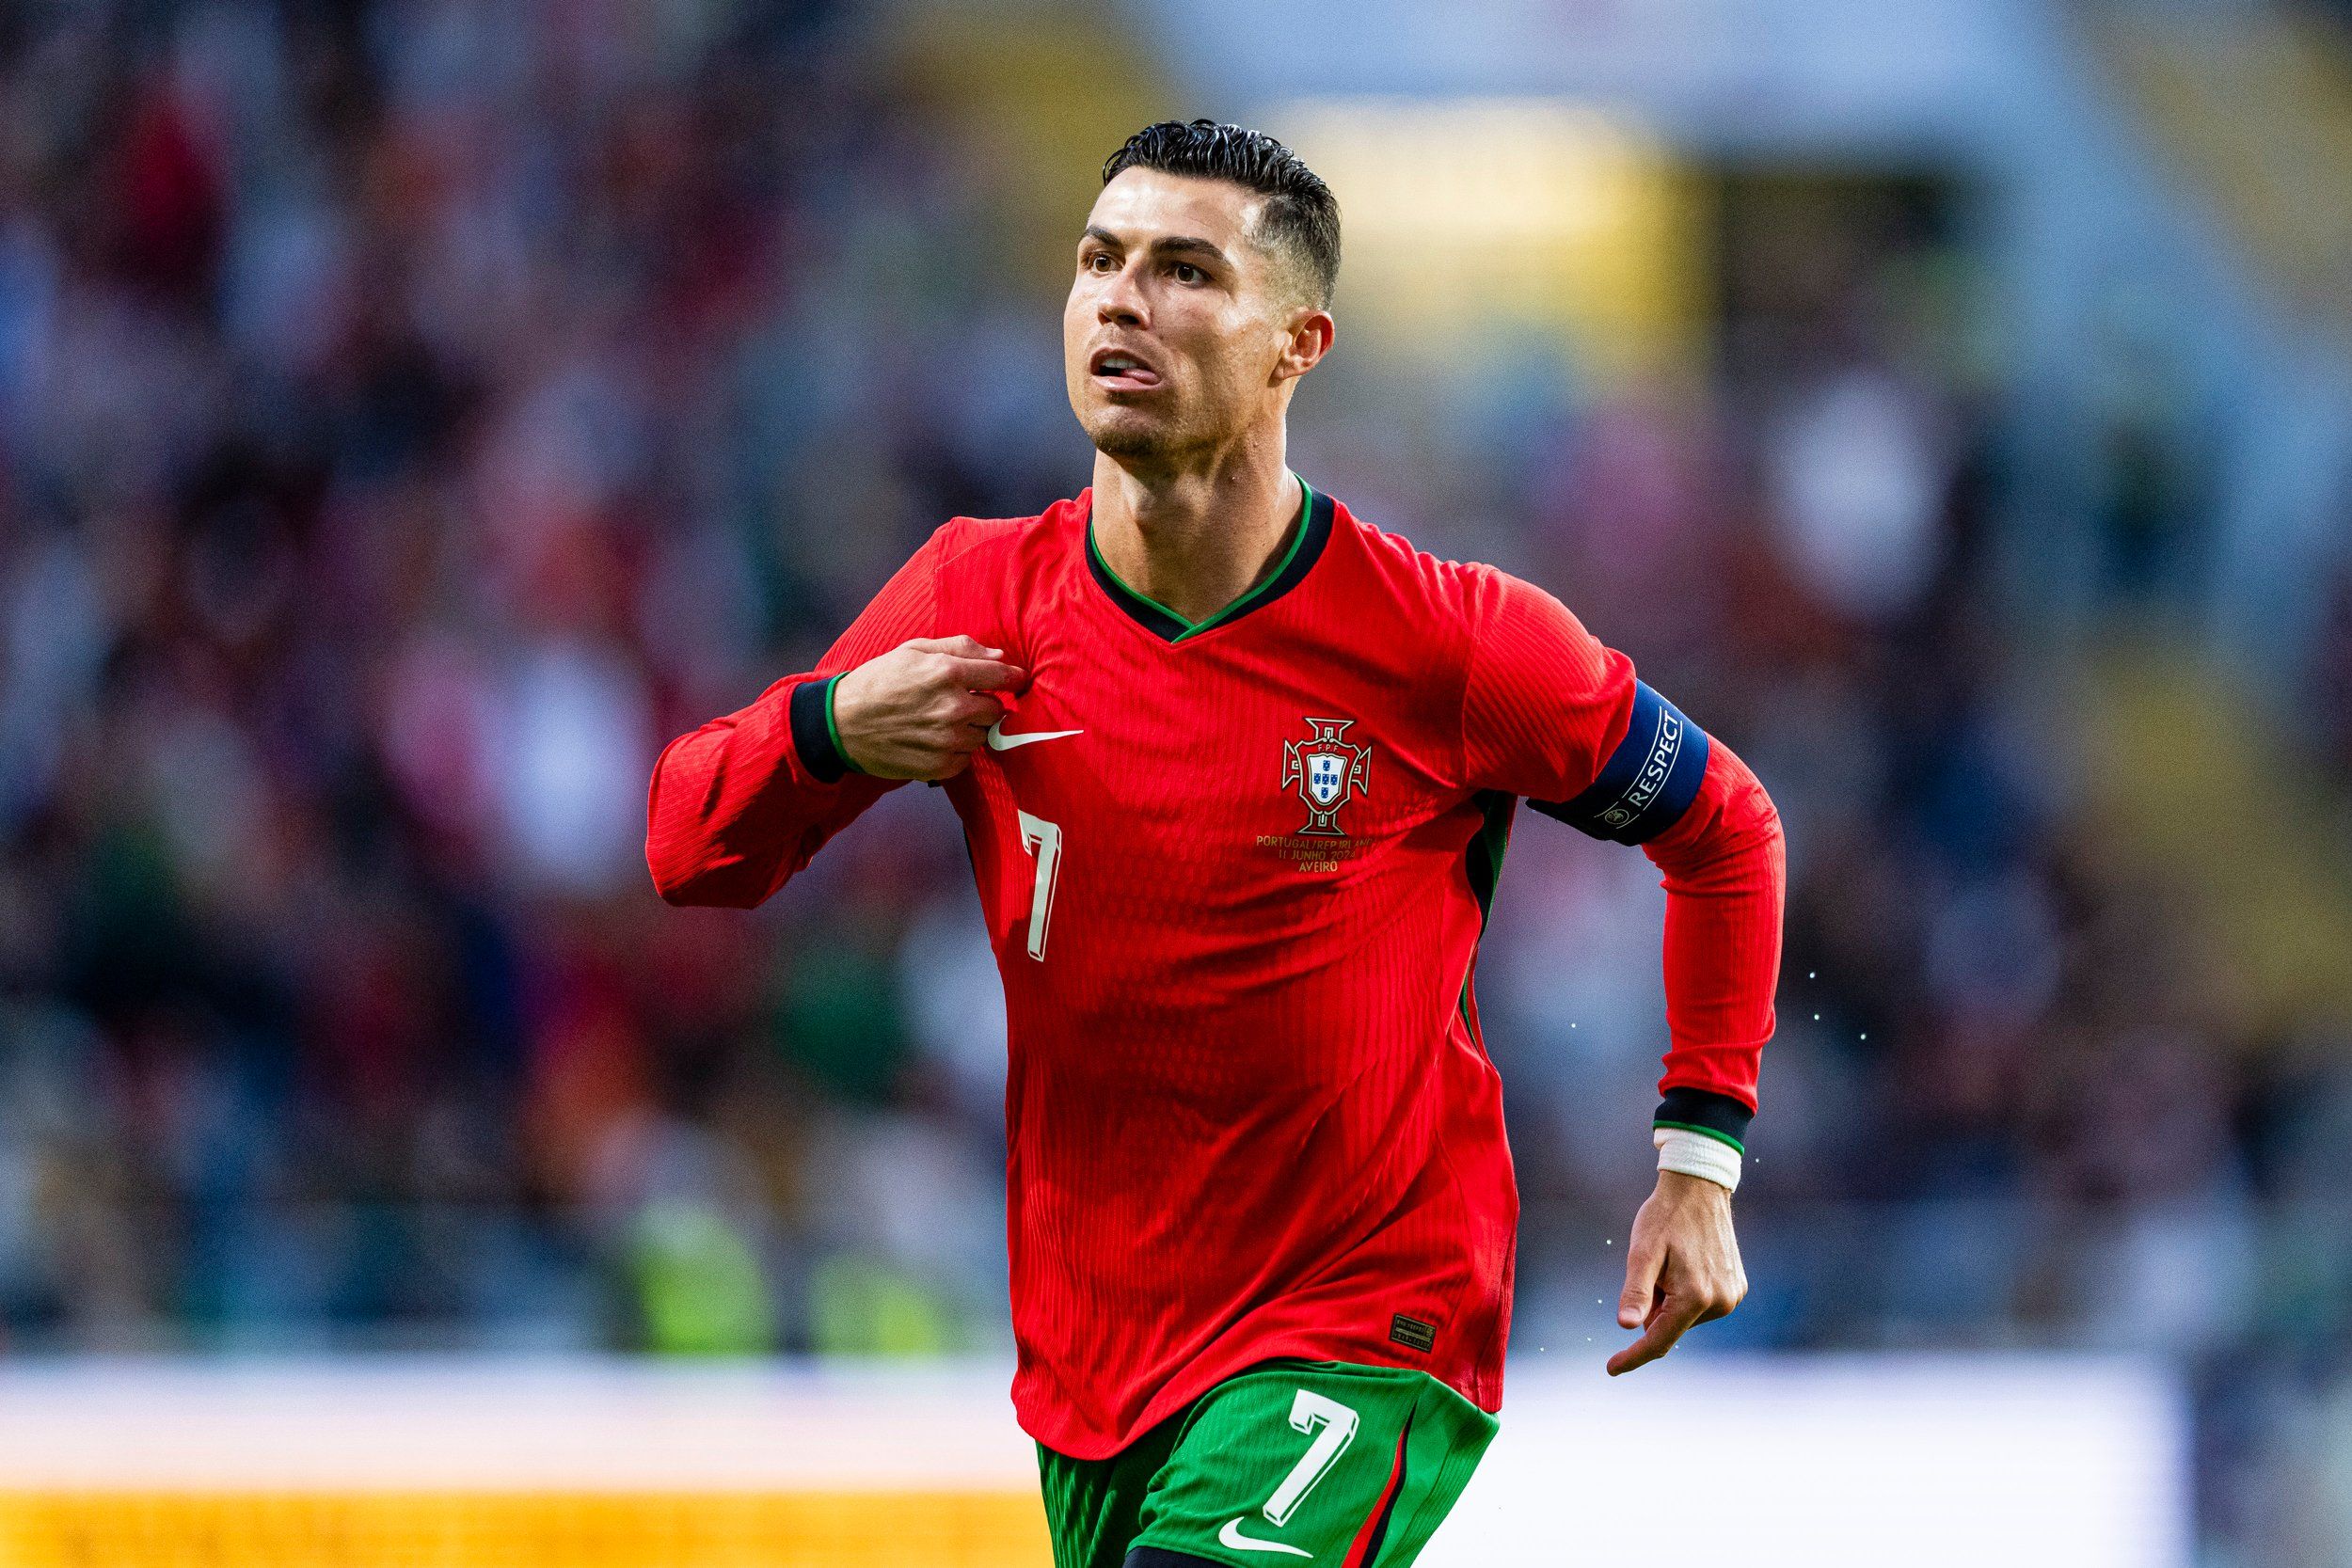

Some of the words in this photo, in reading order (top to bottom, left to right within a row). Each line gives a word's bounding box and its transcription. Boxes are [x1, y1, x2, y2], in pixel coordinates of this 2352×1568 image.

[1628, 709, 1679, 807] RESPECT
[1017, 808, 1062, 963] 7
[1291, 849, 1327, 861] JUNHO
[1298, 861, 1339, 873] AVEIRO
[1262, 1388, 1360, 1528] 7
